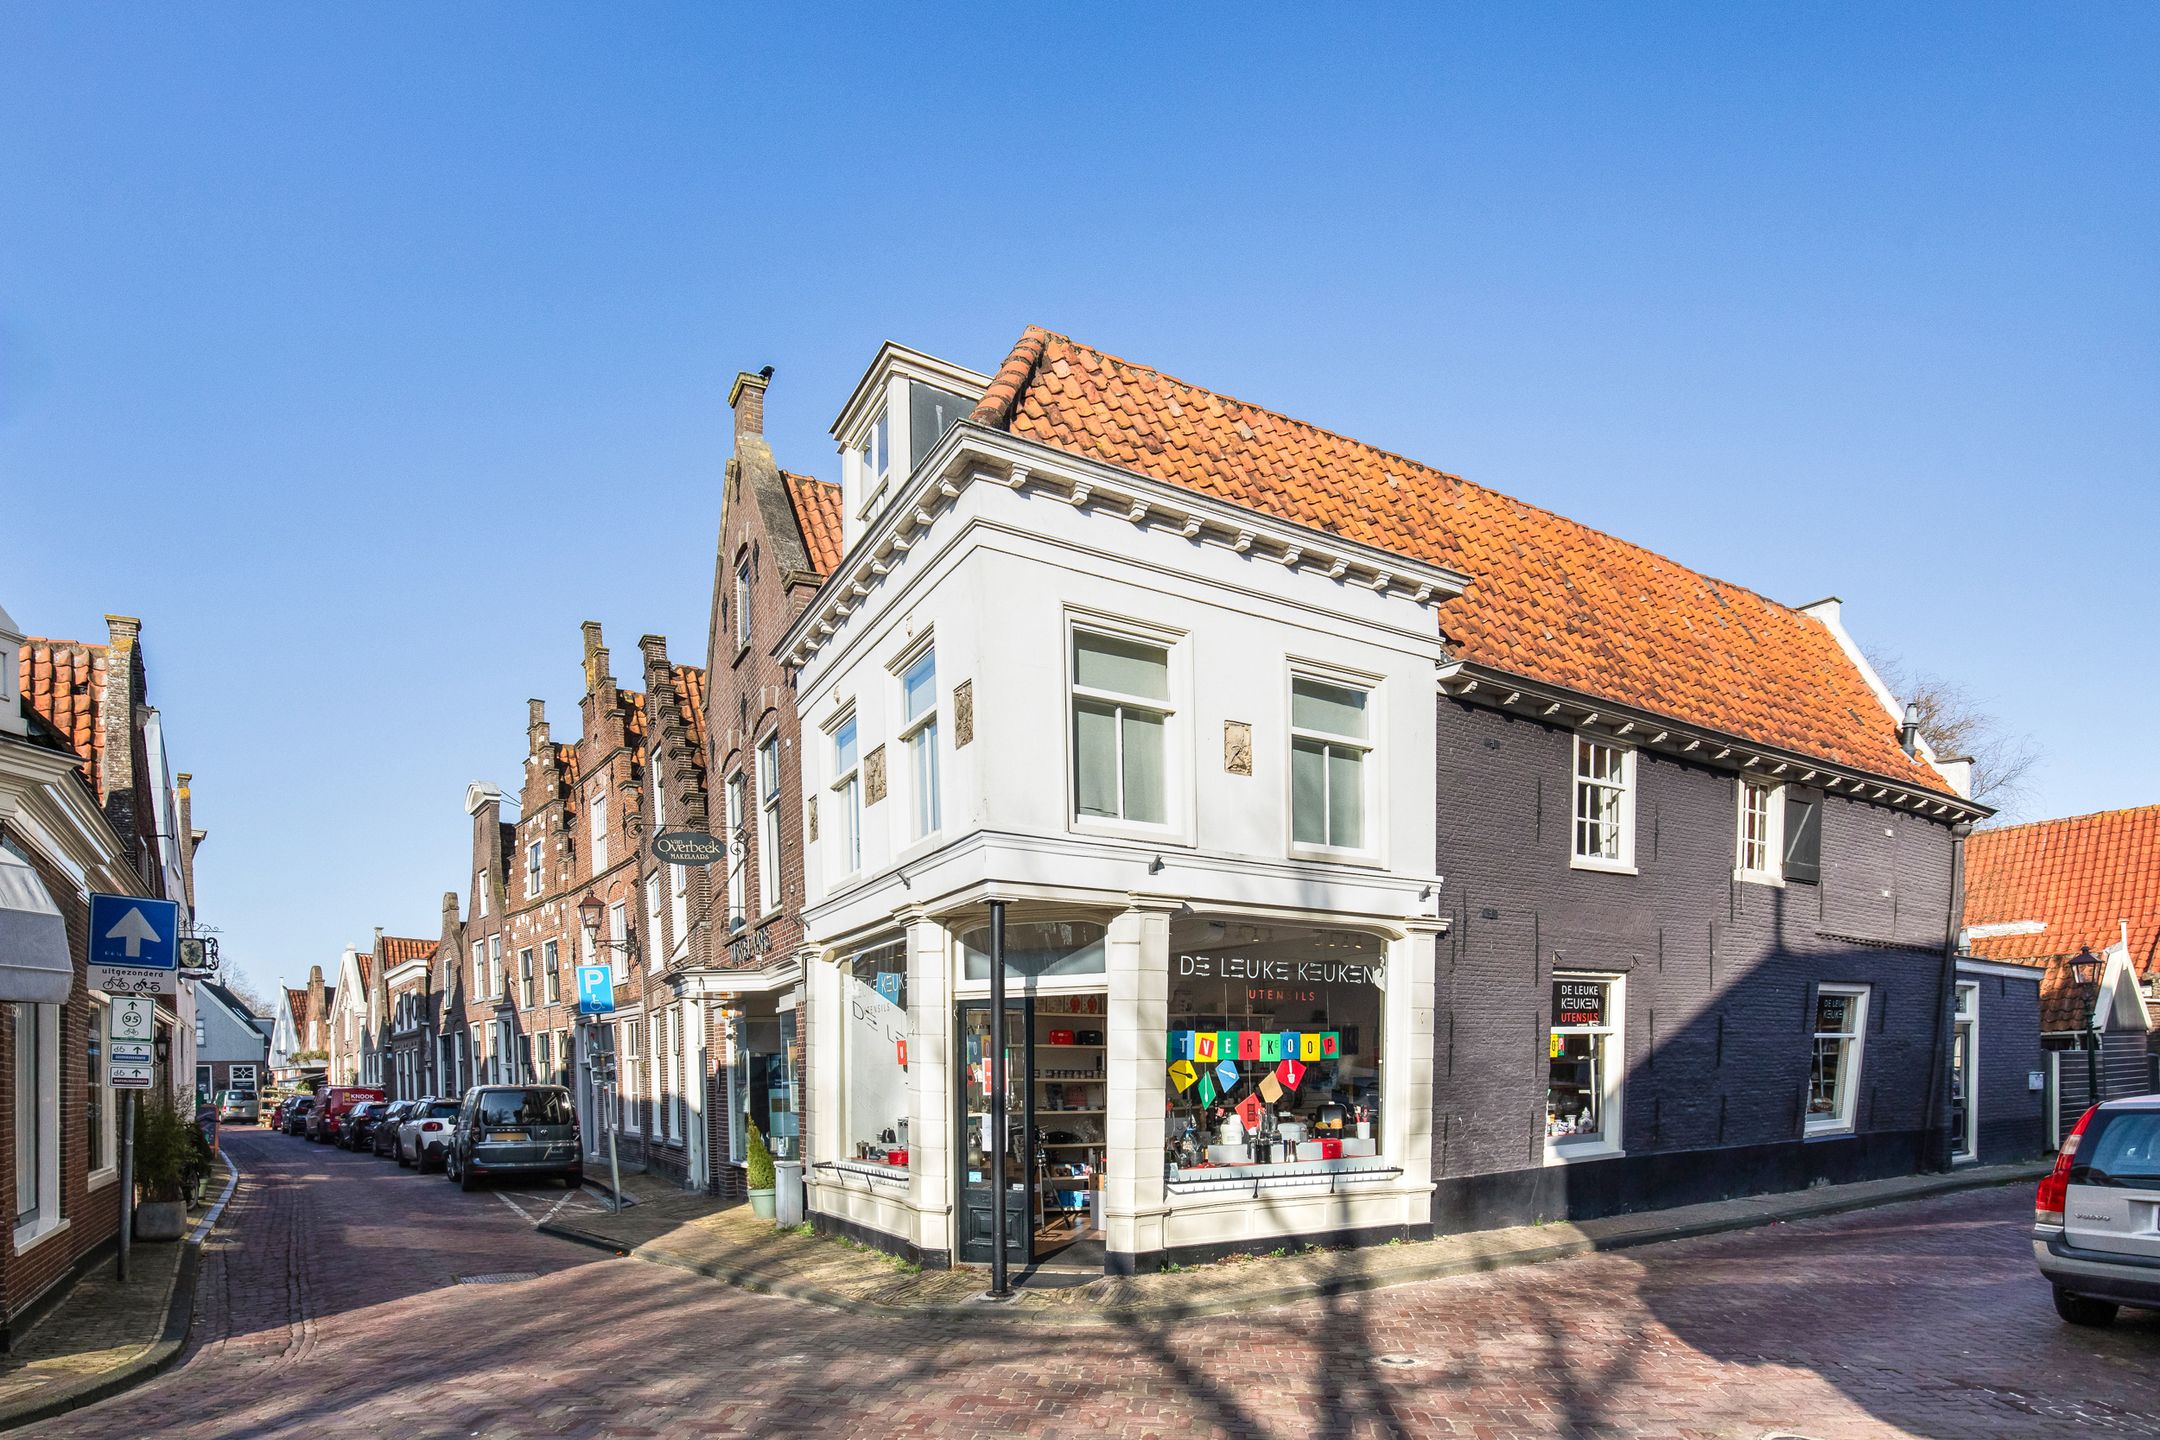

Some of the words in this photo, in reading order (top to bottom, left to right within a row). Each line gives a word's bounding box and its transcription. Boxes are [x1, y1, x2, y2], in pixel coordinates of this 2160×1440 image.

[657, 839, 720, 855] Overbeek
[102, 967, 164, 977] uitgezonderd
[1180, 955, 1211, 977] DE
[1220, 957, 1289, 982] LEUKE
[1298, 961, 1376, 985] KEUKEN
[584, 969, 604, 994] P
[1248, 989, 1316, 1001] UTENILS
[1561, 985, 1573, 995] DE
[1574, 985, 1599, 996] LEUKE
[1561, 998, 1599, 1009] KEUKEN
[125, 1015, 139, 1023] 95
[1561, 1012, 1599, 1023] UTENSILS
